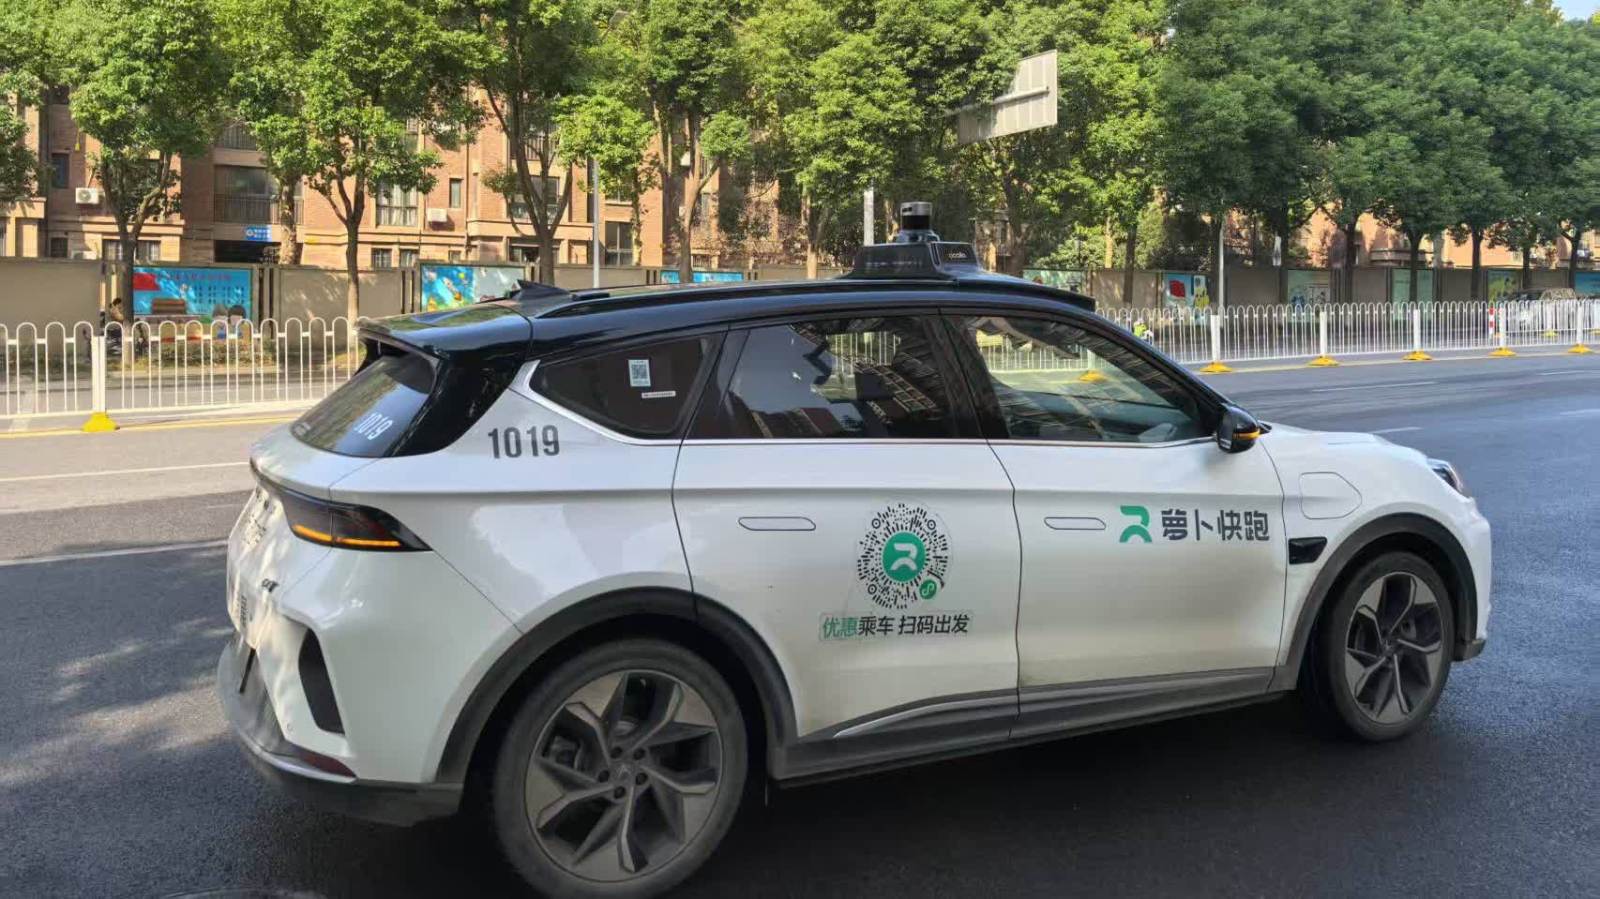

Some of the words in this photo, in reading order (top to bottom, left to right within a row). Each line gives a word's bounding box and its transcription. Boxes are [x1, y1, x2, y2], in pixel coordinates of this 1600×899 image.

[353, 411, 394, 441] 1019
[487, 424, 560, 459] 1019
[1160, 508, 1270, 542] 萝卜快跑
[822, 615, 895, 639] 优惠乘车
[898, 613, 970, 635] 扫码出发
